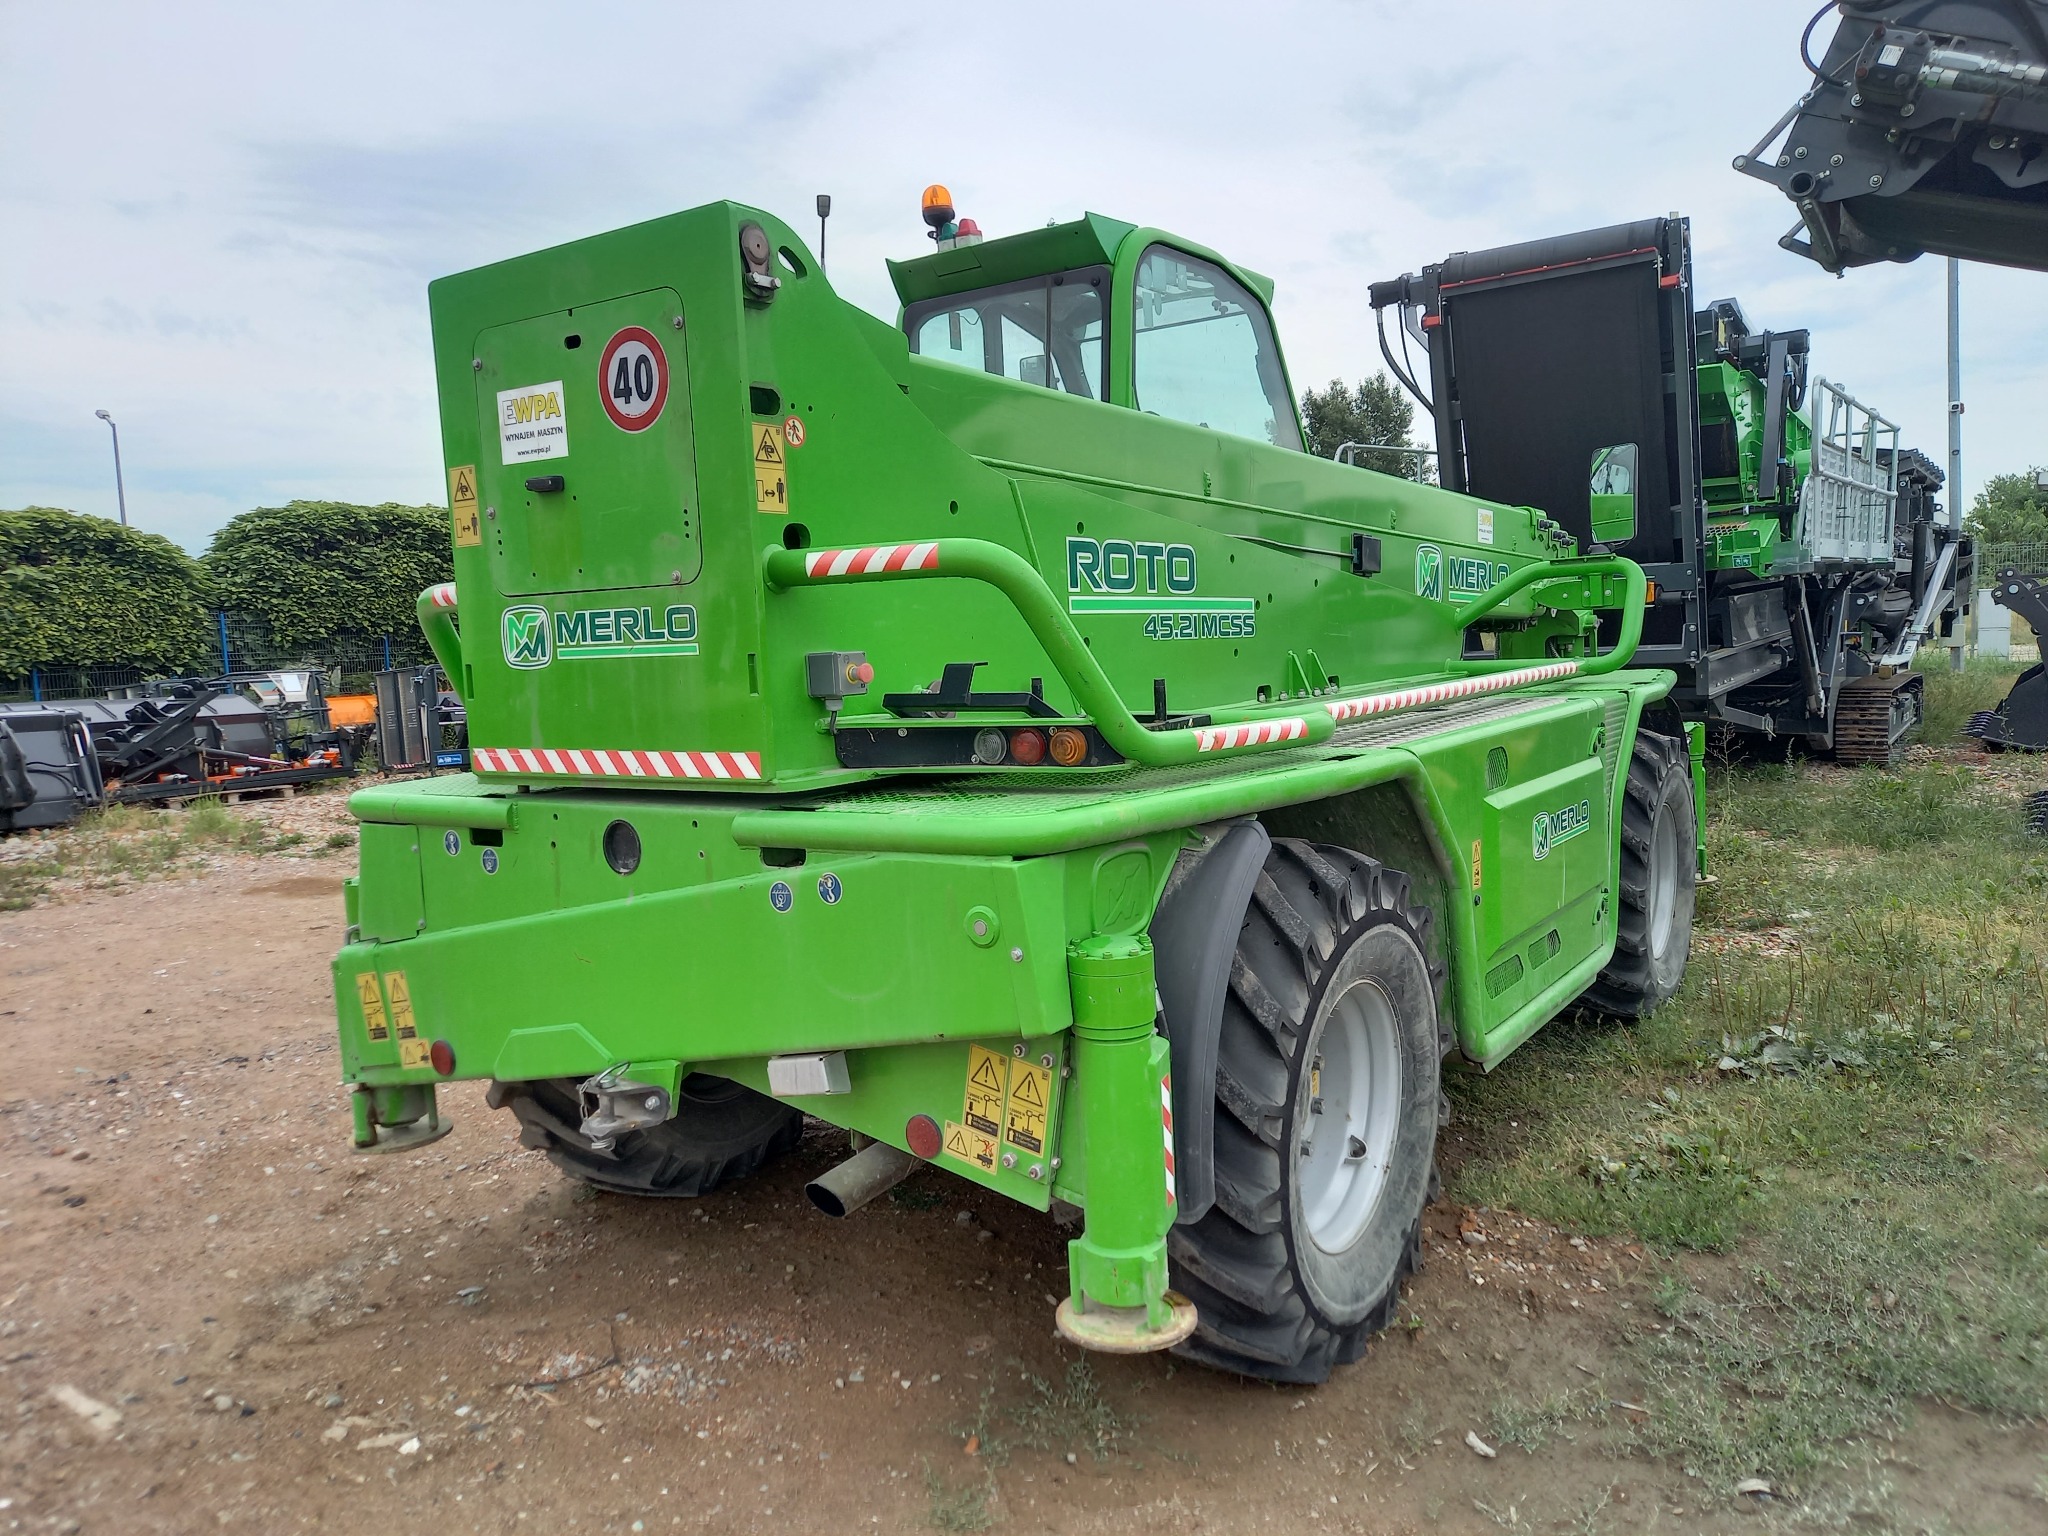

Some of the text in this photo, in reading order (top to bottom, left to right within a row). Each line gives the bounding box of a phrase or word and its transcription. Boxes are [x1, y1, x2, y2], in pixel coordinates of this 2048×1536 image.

[613, 354, 653, 404] 40
[502, 392, 561, 426] EWPA
[505, 426, 563, 442] WYNAJEM MASZYN
[1066, 537, 1197, 594] ROTO
[555, 604, 698, 645] MERLO
[1200, 613, 1255, 639] MCSS
[1550, 799, 1589, 838] MERLO
